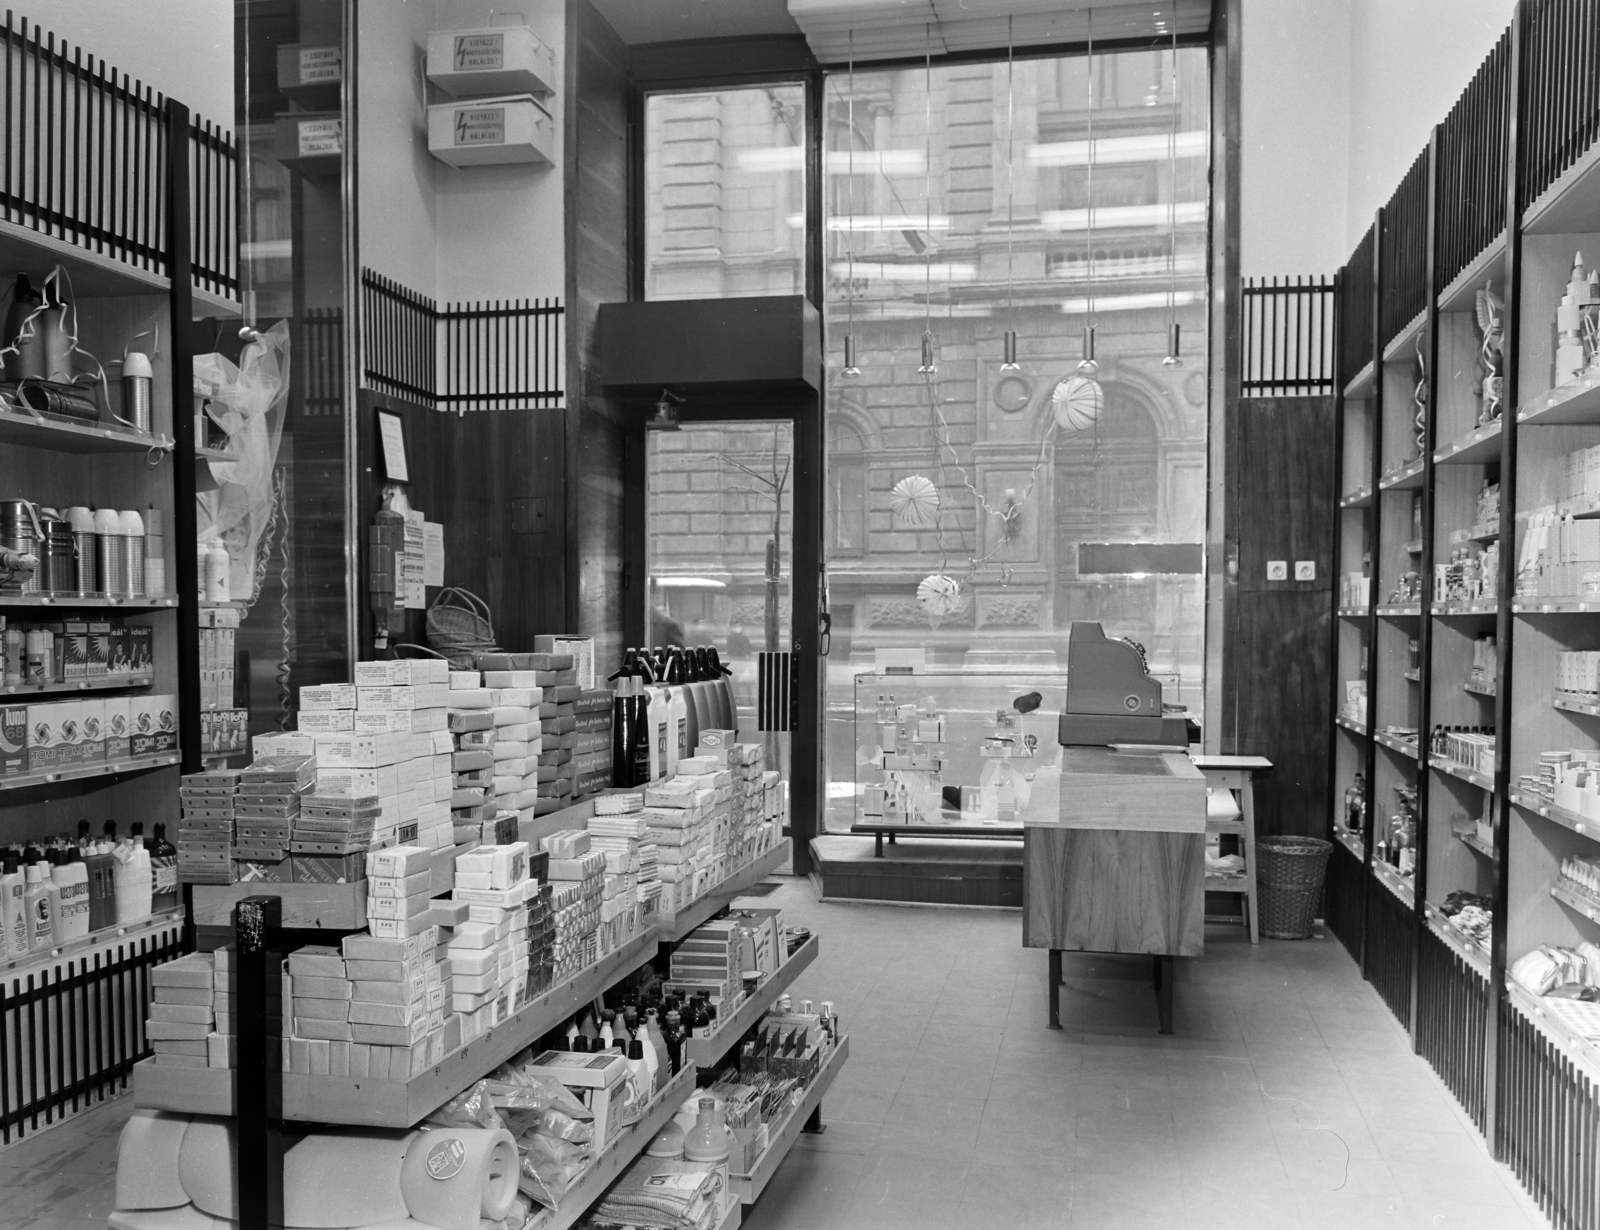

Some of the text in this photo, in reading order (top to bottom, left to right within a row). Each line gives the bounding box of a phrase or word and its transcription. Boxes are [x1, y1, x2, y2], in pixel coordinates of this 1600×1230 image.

[5, 708, 26, 727] luna
[32, 749, 56, 760] TOMI
[59, 745, 82, 757] TOMI
